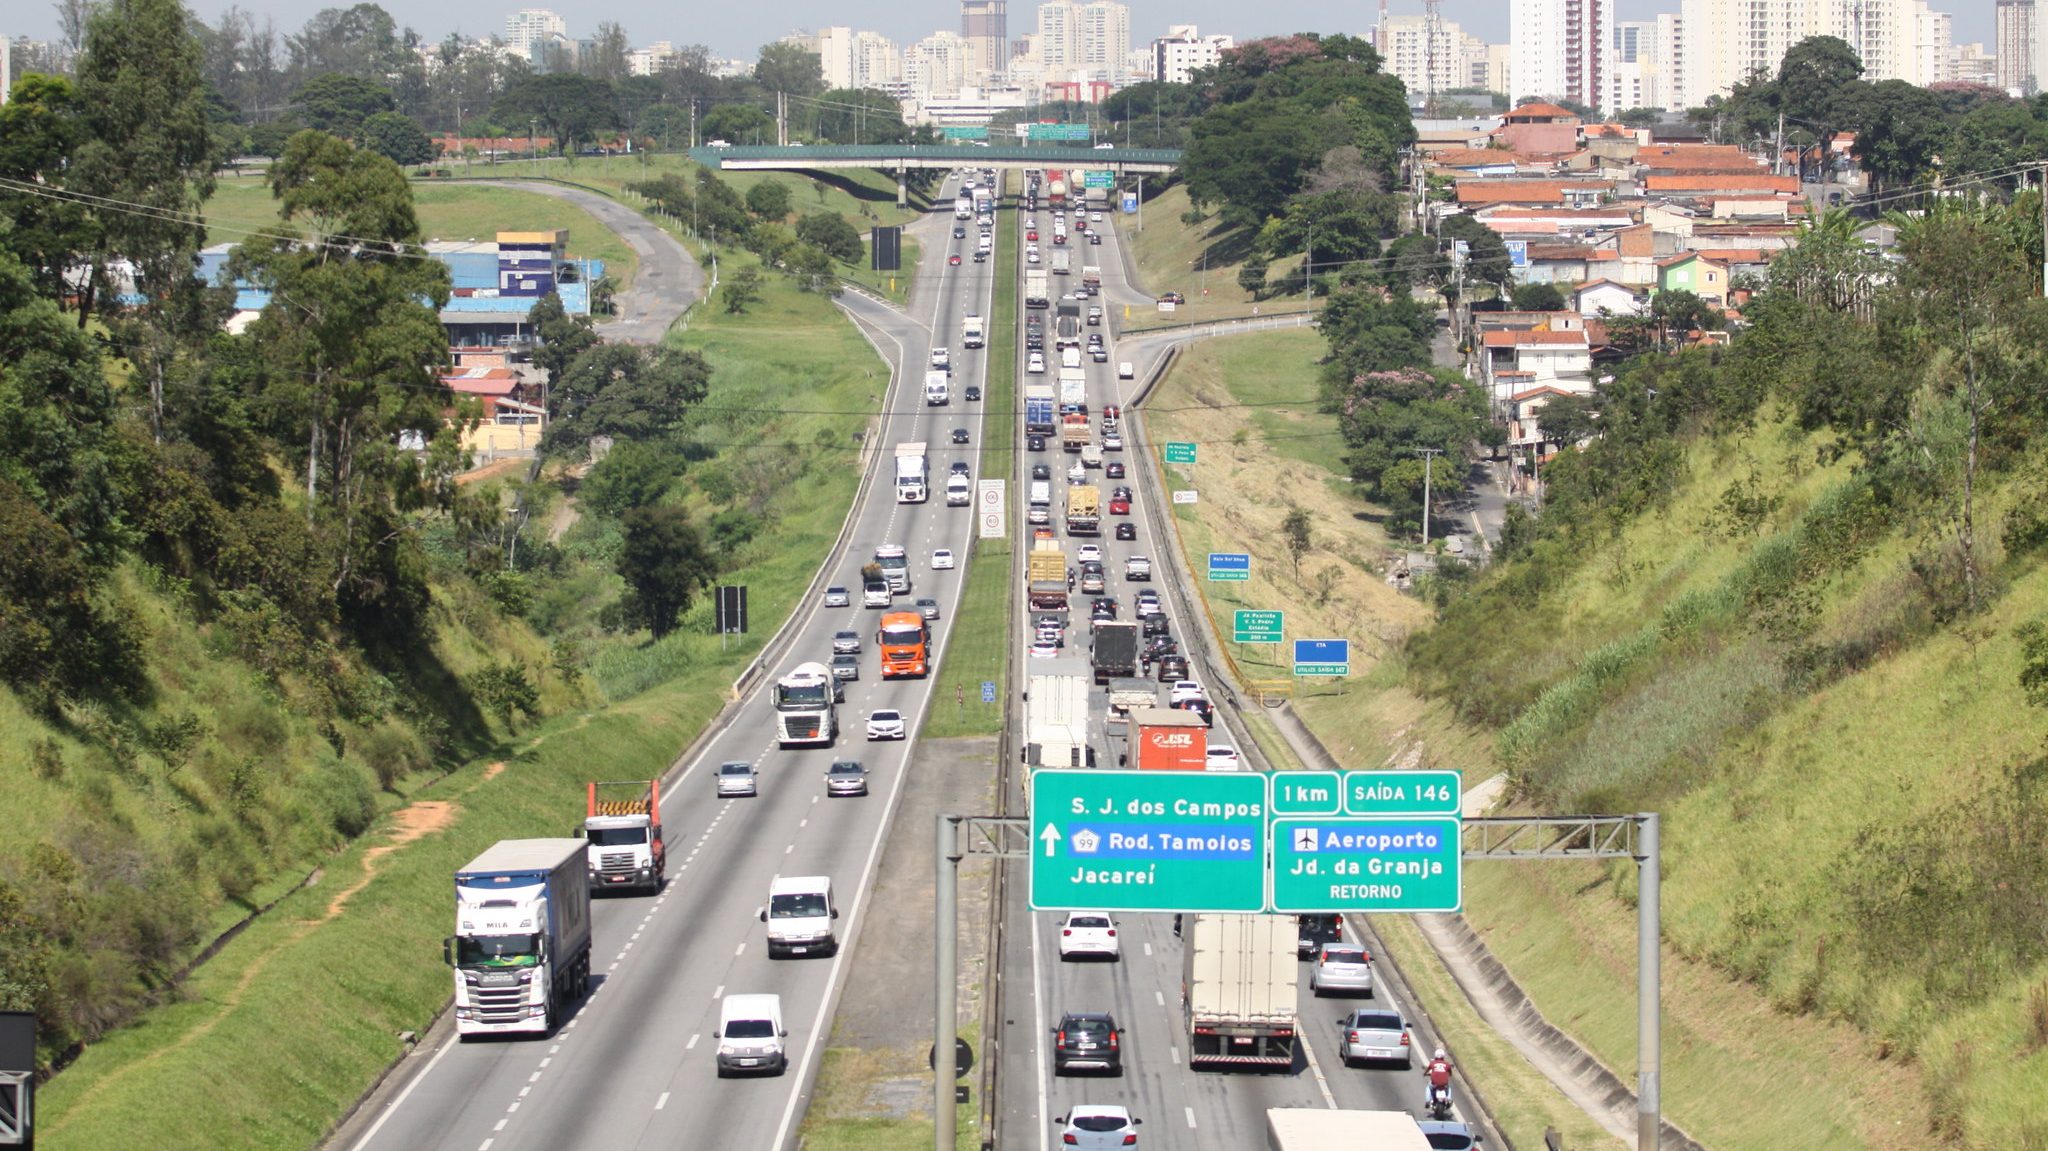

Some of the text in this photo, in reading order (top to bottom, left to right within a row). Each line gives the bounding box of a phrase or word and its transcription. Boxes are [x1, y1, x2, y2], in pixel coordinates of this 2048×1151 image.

[1284, 785, 1328, 802] 1 km
[1354, 781, 1450, 801] SAÍDA 146
[1071, 797, 1261, 820] S. J. dos Campos
[1080, 832, 1252, 851] 99 Rod. Tamoios
[1325, 831, 1438, 851] Aeroporto
[1070, 863, 1156, 885] Jacareí
[1290, 858, 1443, 879] Jd. da Granja
[1330, 884, 1402, 899] RETORNO
